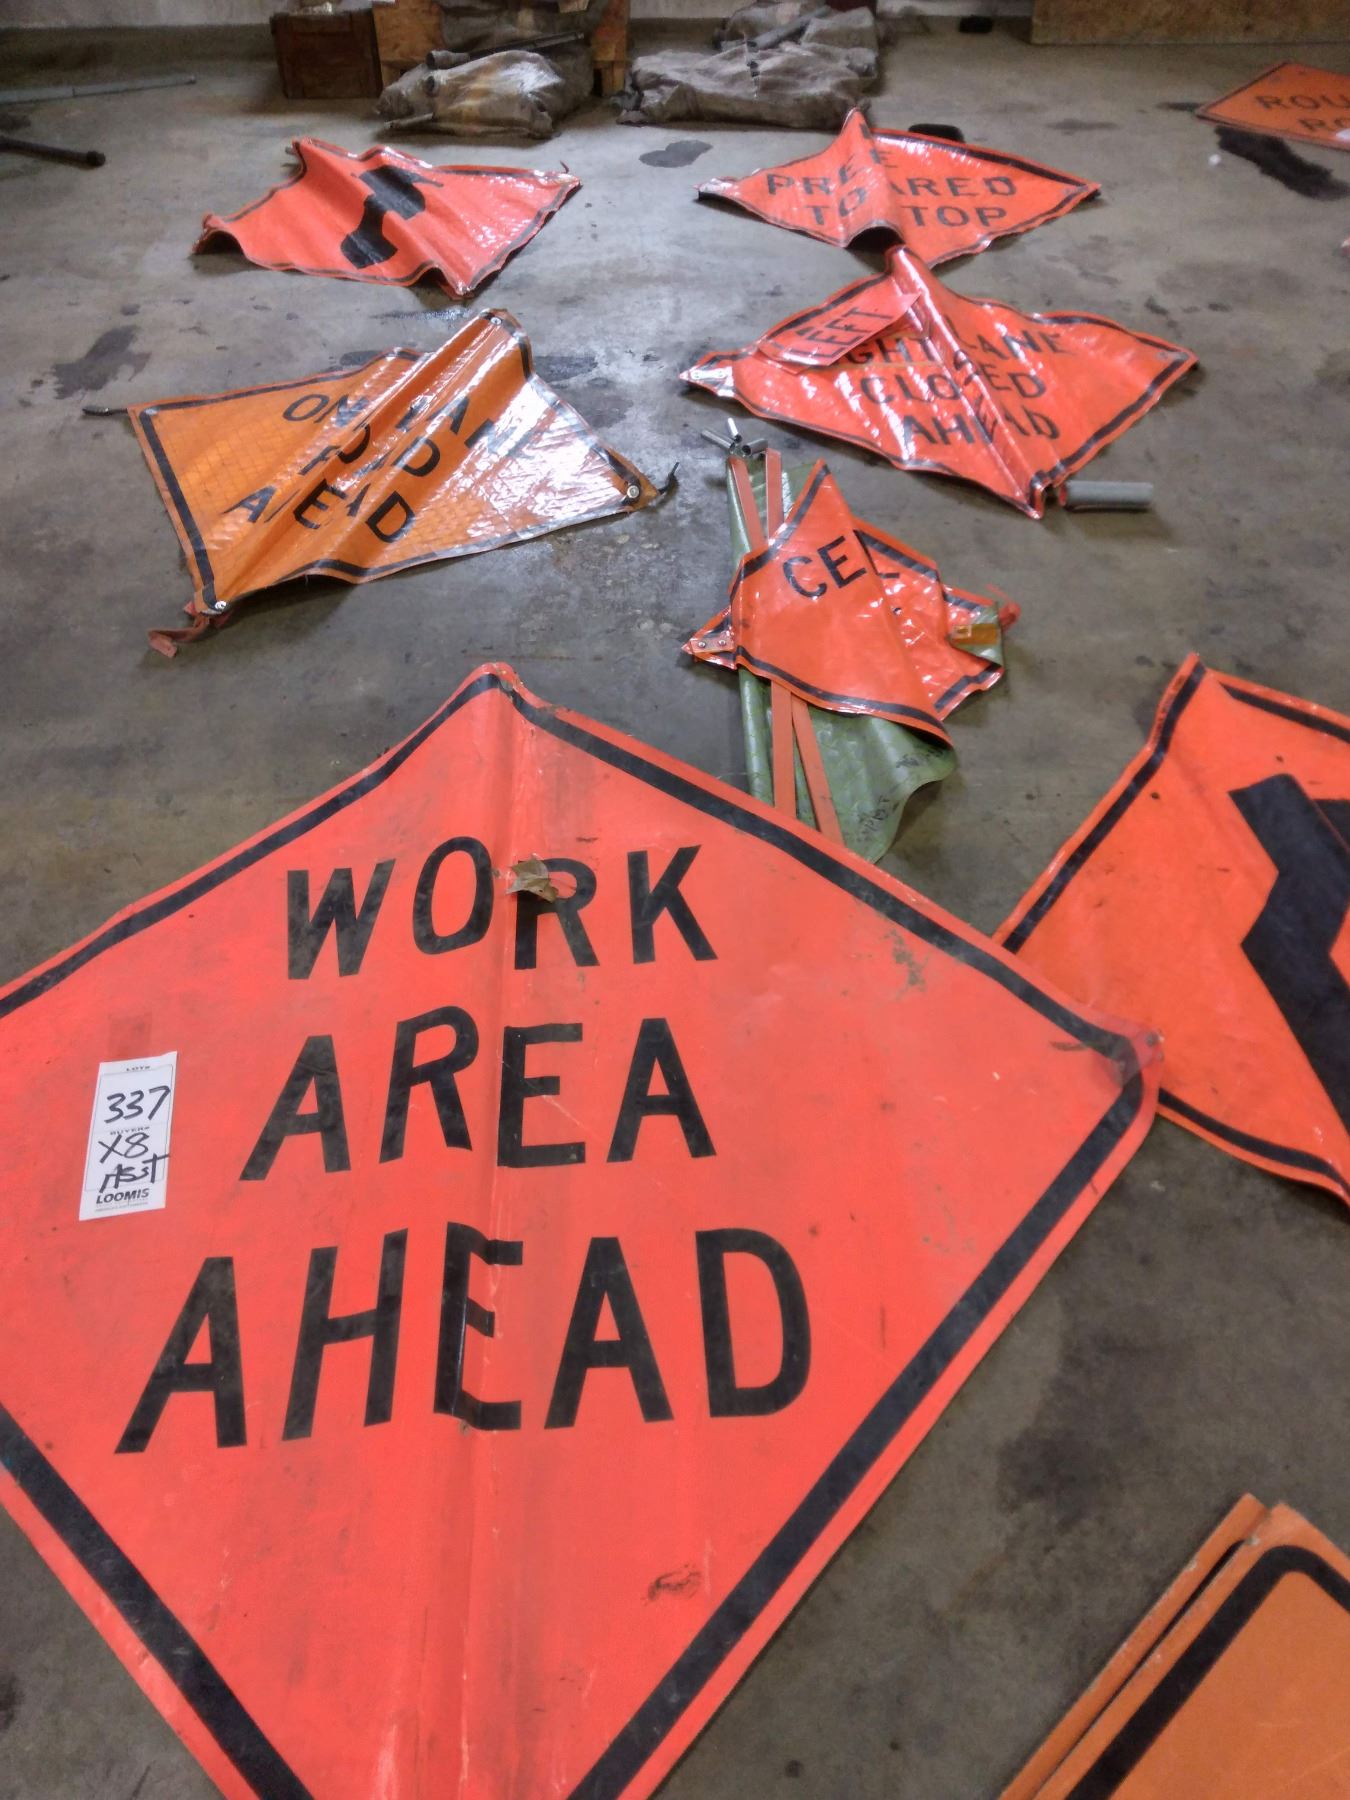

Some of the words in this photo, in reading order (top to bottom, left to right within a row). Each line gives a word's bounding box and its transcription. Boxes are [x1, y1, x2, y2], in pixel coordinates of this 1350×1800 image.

[804, 187, 867, 226] TO
[900, 205, 1007, 227] TOP
[788, 306, 893, 358] LEFT
[286, 836, 718, 981] WORK
[104, 1085, 171, 1124] 337
[238, 1005, 717, 1182] AREA
[96, 1187, 150, 1205] LOOMIS
[113, 1221, 812, 1455] AHEAD
